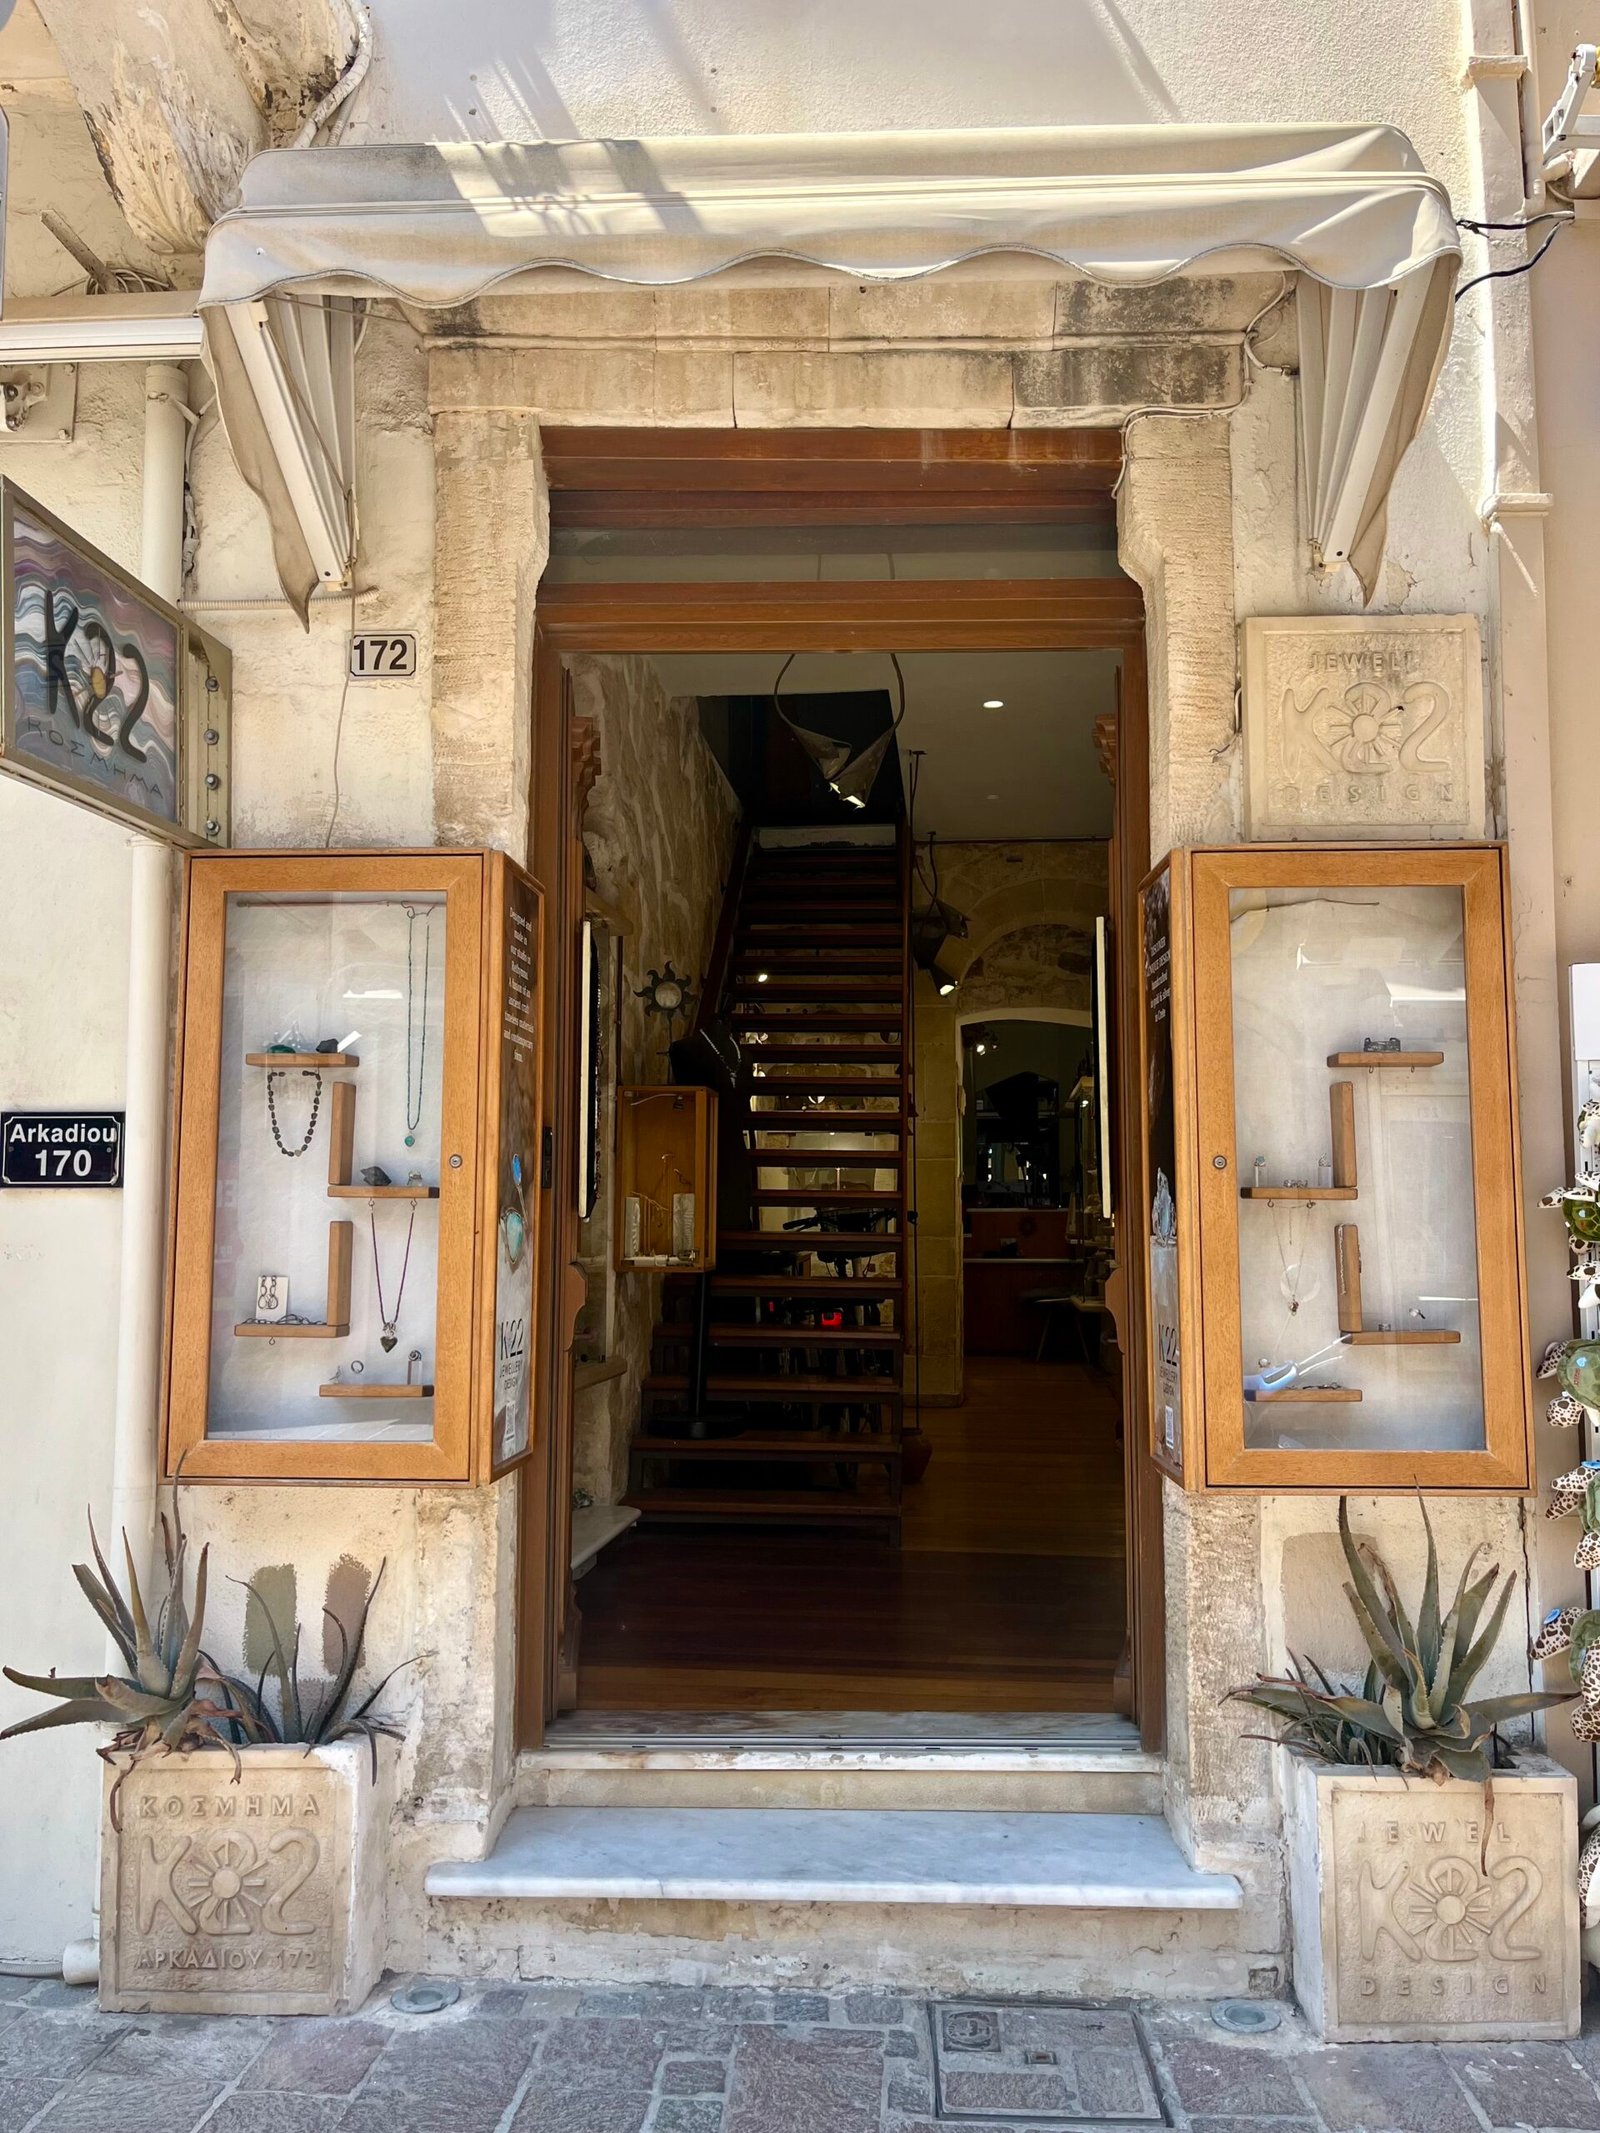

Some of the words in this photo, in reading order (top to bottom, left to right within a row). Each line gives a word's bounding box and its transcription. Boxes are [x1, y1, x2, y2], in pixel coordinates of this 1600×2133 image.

[354, 639, 407, 670] 172
[28, 716, 163, 799] ΚΟΣΜΗΜΑ
[1283, 783, 1454, 802] DESIGN
[10, 1123, 117, 1143] Arkadiou
[35, 1149, 92, 1176] 170
[140, 1795, 321, 1817] ΚΟΣΜΗΜΑ
[1358, 1820, 1512, 1844] JEWEL
[134, 1949, 263, 1970] ΑΡΚΑΔΙΟΥ
[276, 1949, 316, 1970] 172
[1360, 1974, 1548, 1996] DESIGN
